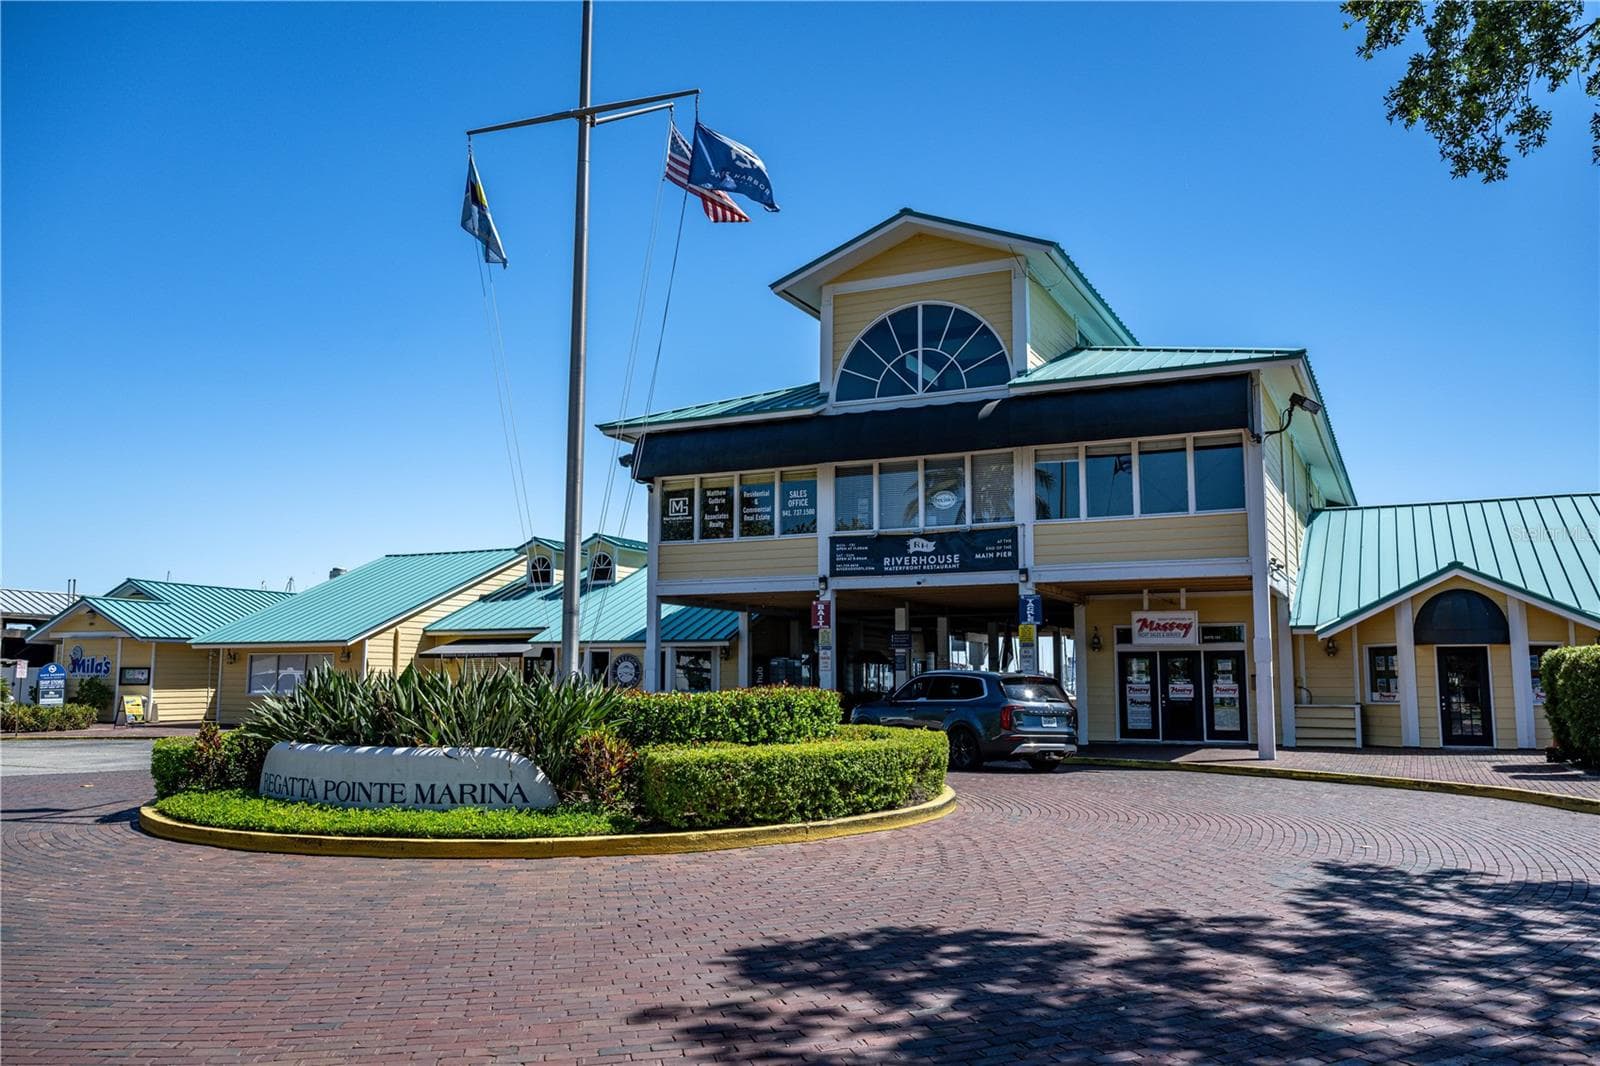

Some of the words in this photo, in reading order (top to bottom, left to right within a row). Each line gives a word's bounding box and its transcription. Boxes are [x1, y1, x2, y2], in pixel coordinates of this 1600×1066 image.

[734, 173, 771, 196] HARBOR
[788, 498, 809, 507] OFFICE
[789, 489, 808, 498] SALES
[883, 554, 960, 566] RIVERHOUSE
[1136, 616, 1193, 637] Massey
[71, 656, 110, 674] Mila's
[264, 772, 317, 800] REGATTA
[324, 780, 406, 803] POINTE
[414, 783, 530, 804] MARINA
